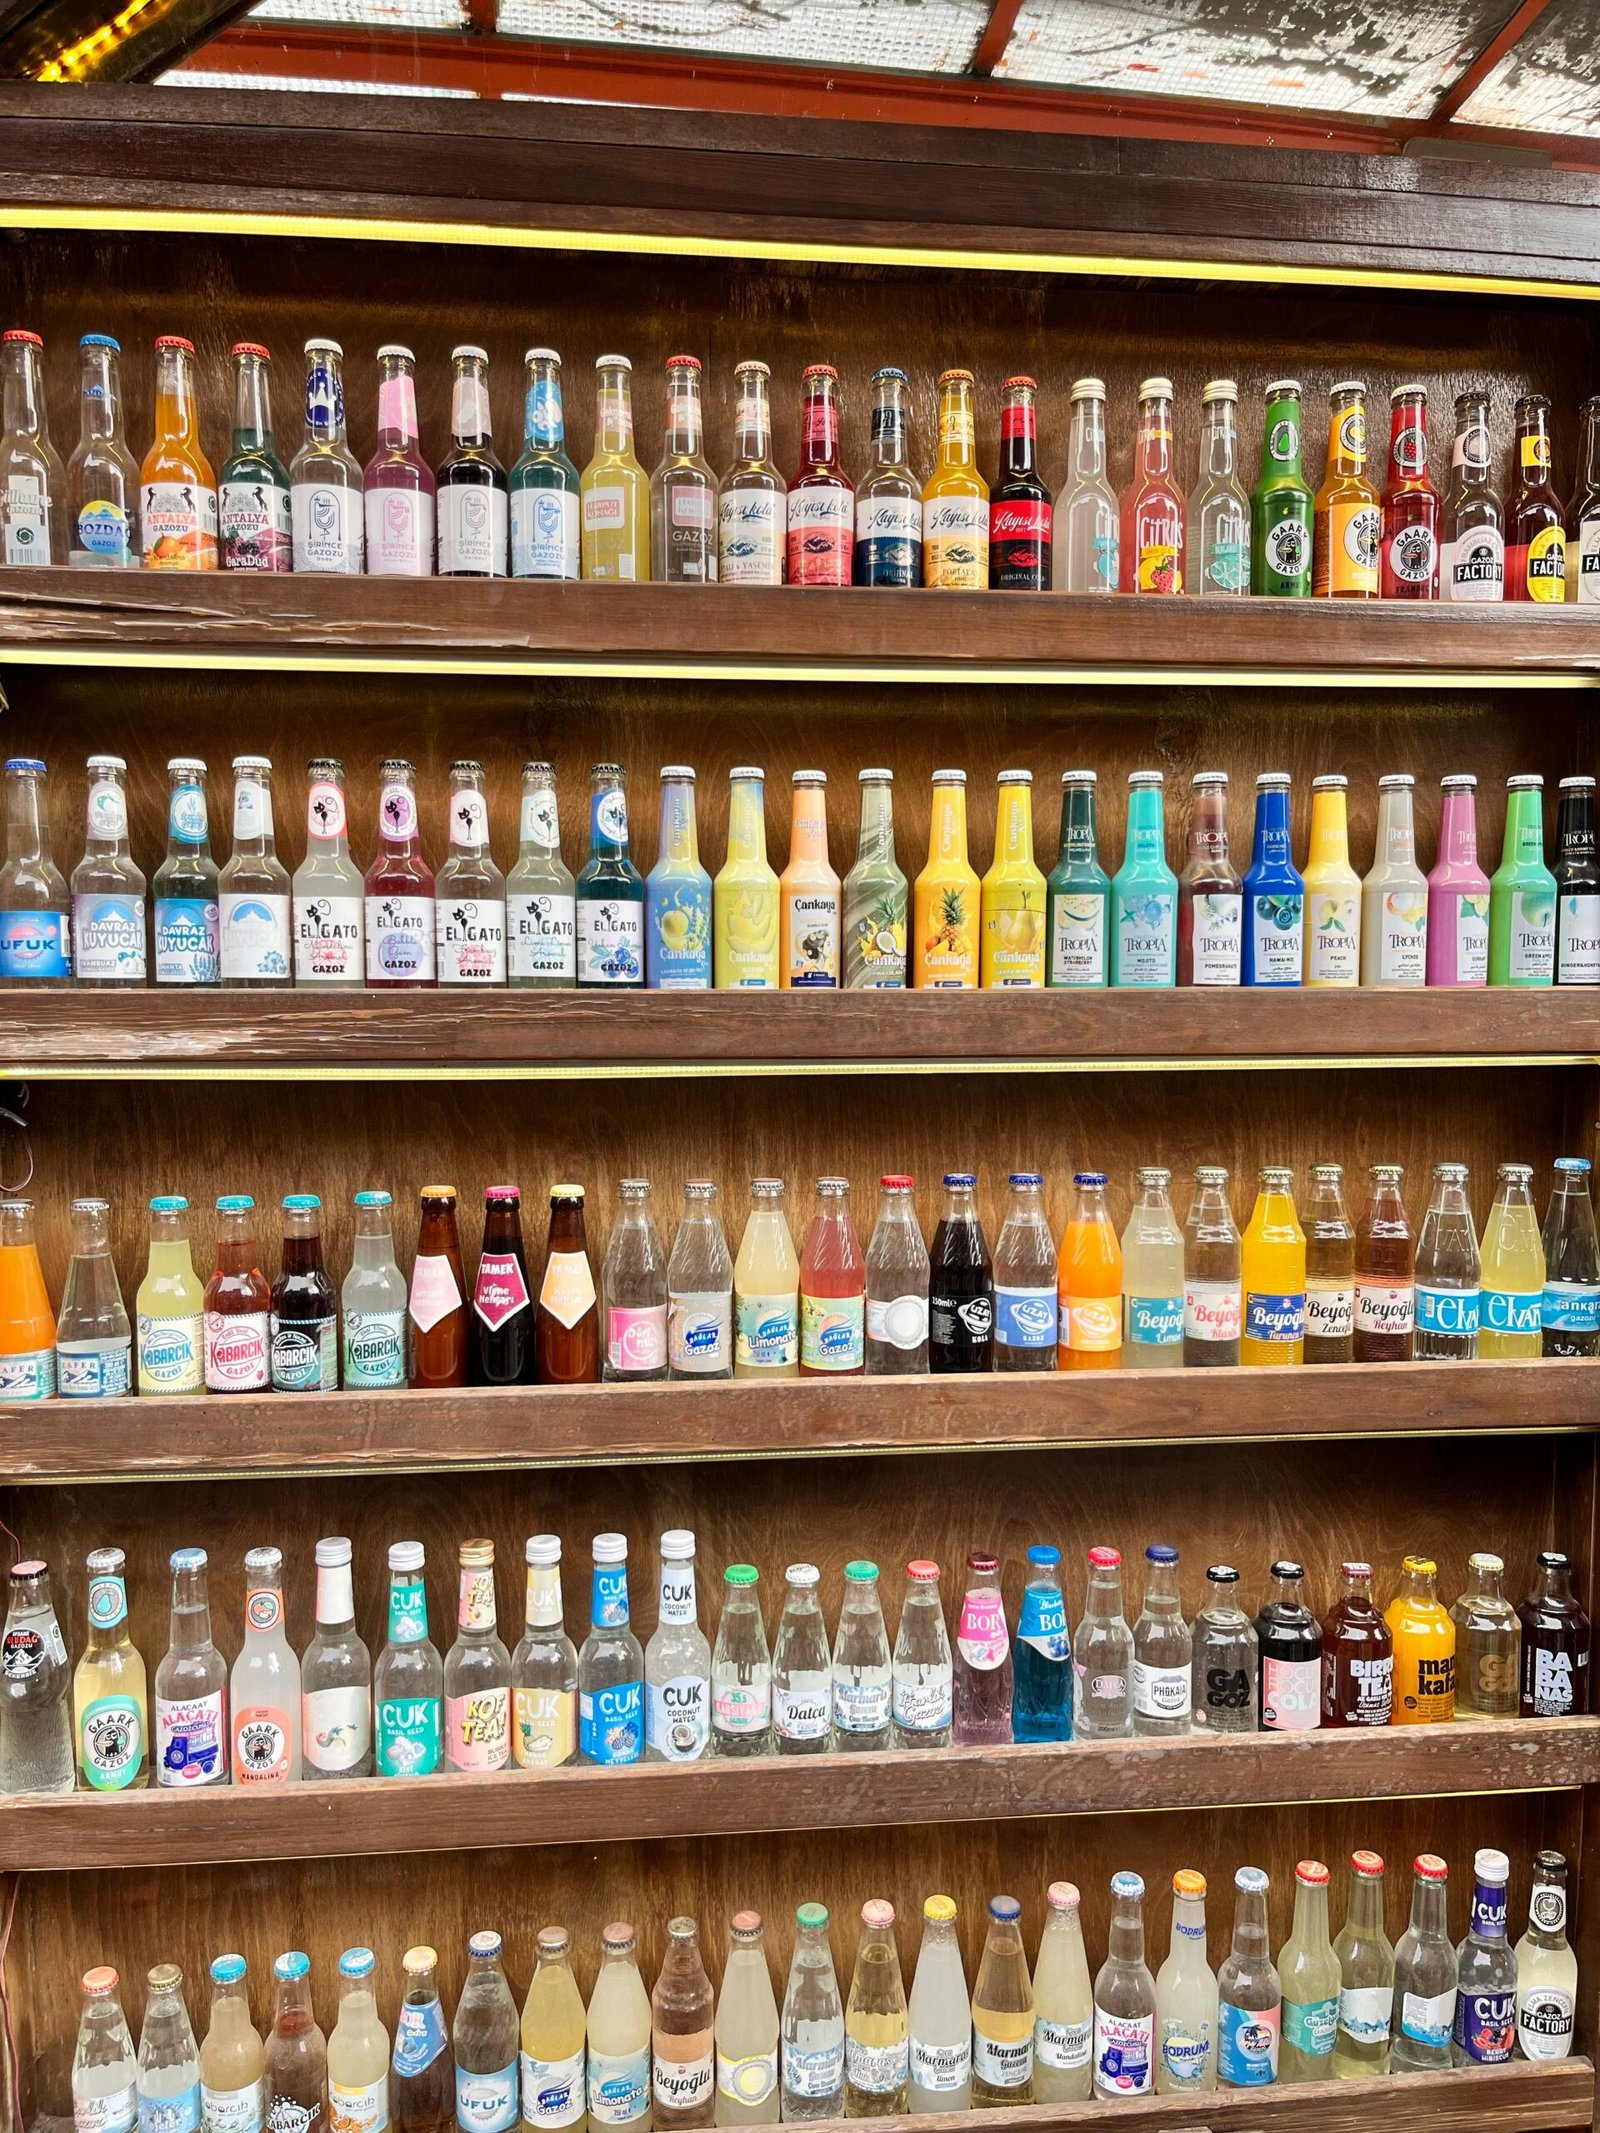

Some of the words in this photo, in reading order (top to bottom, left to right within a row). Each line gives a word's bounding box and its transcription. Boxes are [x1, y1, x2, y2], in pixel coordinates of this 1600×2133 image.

[147, 511, 197, 525] ANTALYA
[222, 511, 269, 525] ANTALYA
[153, 523, 188, 533] GAZOZU
[227, 523, 259, 532] GAZOZU
[671, 529, 714, 546] GAZOZ
[308, 547, 344, 558] GAZOZU
[381, 550, 417, 560] GAZOZU
[457, 548, 492, 558] GAZOZU
[531, 553, 565, 564] GAZOZU
[226, 555, 269, 571] GaraDud
[1457, 562, 1503, 585] FACTORY
[90, 921, 137, 933] DAVRAZ
[162, 925, 205, 937] DAVRAZ
[1, 939, 55, 951] UFUK
[83, 929, 142, 950] KUYUCAK
[157, 935, 214, 955] KUYUCAK
[1058, 936, 1098, 952] TROPIA
[1124, 937, 1167, 952] TROPIA
[1199, 937, 1239, 953] TROPIA
[1260, 937, 1300, 952] TROPIA
[1317, 935, 1356, 951] TROPIA
[312, 964, 345, 974] GAZOZ
[385, 960, 418, 970] GAZOZ
[459, 967, 493, 978] GAZOZ
[532, 962, 564, 972] GAZOZ
[600, 963, 633, 974] GAZOZ
[480, 1263, 515, 1276] TAMEK
[1373, 1319, 1408, 1333] Reyhan
[348, 1335, 401, 1365] KABARCIK
[684, 1342, 721, 1357] Gazoz
[748, 1331, 797, 1353] Limonata
[140, 1341, 193, 1371] KABARCIK
[210, 1338, 264, 1369] KABARCIK
[820, 1341, 855, 1362] Gazoz
[390, 1590, 425, 1610] CUK
[662, 1584, 693, 1602] CUK
[967, 1613, 1001, 1632] BOR
[1536, 1647, 1573, 1672] BA
[1206, 1668, 1251, 1692] GA
[1536, 1670, 1572, 1690] BA
[599, 1688, 641, 1714] CUK
[662, 1683, 703, 1708] CUK
[1206, 1690, 1251, 1709] GOZ
[1268, 1691, 1317, 1711] COLA
[1536, 1688, 1573, 1703] NAS
[515, 1693, 561, 1719] CUK
[667, 1707, 701, 1720] COCONUT
[162, 1709, 219, 1729] ALAÇATI
[382, 1701, 430, 1729] CUK
[672, 1715, 697, 1724] WATER
[88, 1714, 135, 1735] GAARK
[241, 1724, 280, 1740] GAARK
[94, 1751, 132, 1769] GAZOZ
[244, 1758, 275, 1770] GAZOZ
[1477, 1902, 1507, 1922] CUK
[1474, 1995, 1516, 2021] CUK
[1536, 2010, 1562, 2019] GAZOZ
[1523, 2013, 1571, 2033] FACTORY
[1101, 2024, 1150, 2044] ALAÇATI
[655, 2066, 712, 2095] Beyoğlu
[460, 2095, 509, 2110] UFUK
[592, 2085, 644, 2107] Limonata
[536, 2098, 574, 2116] Gazoz
